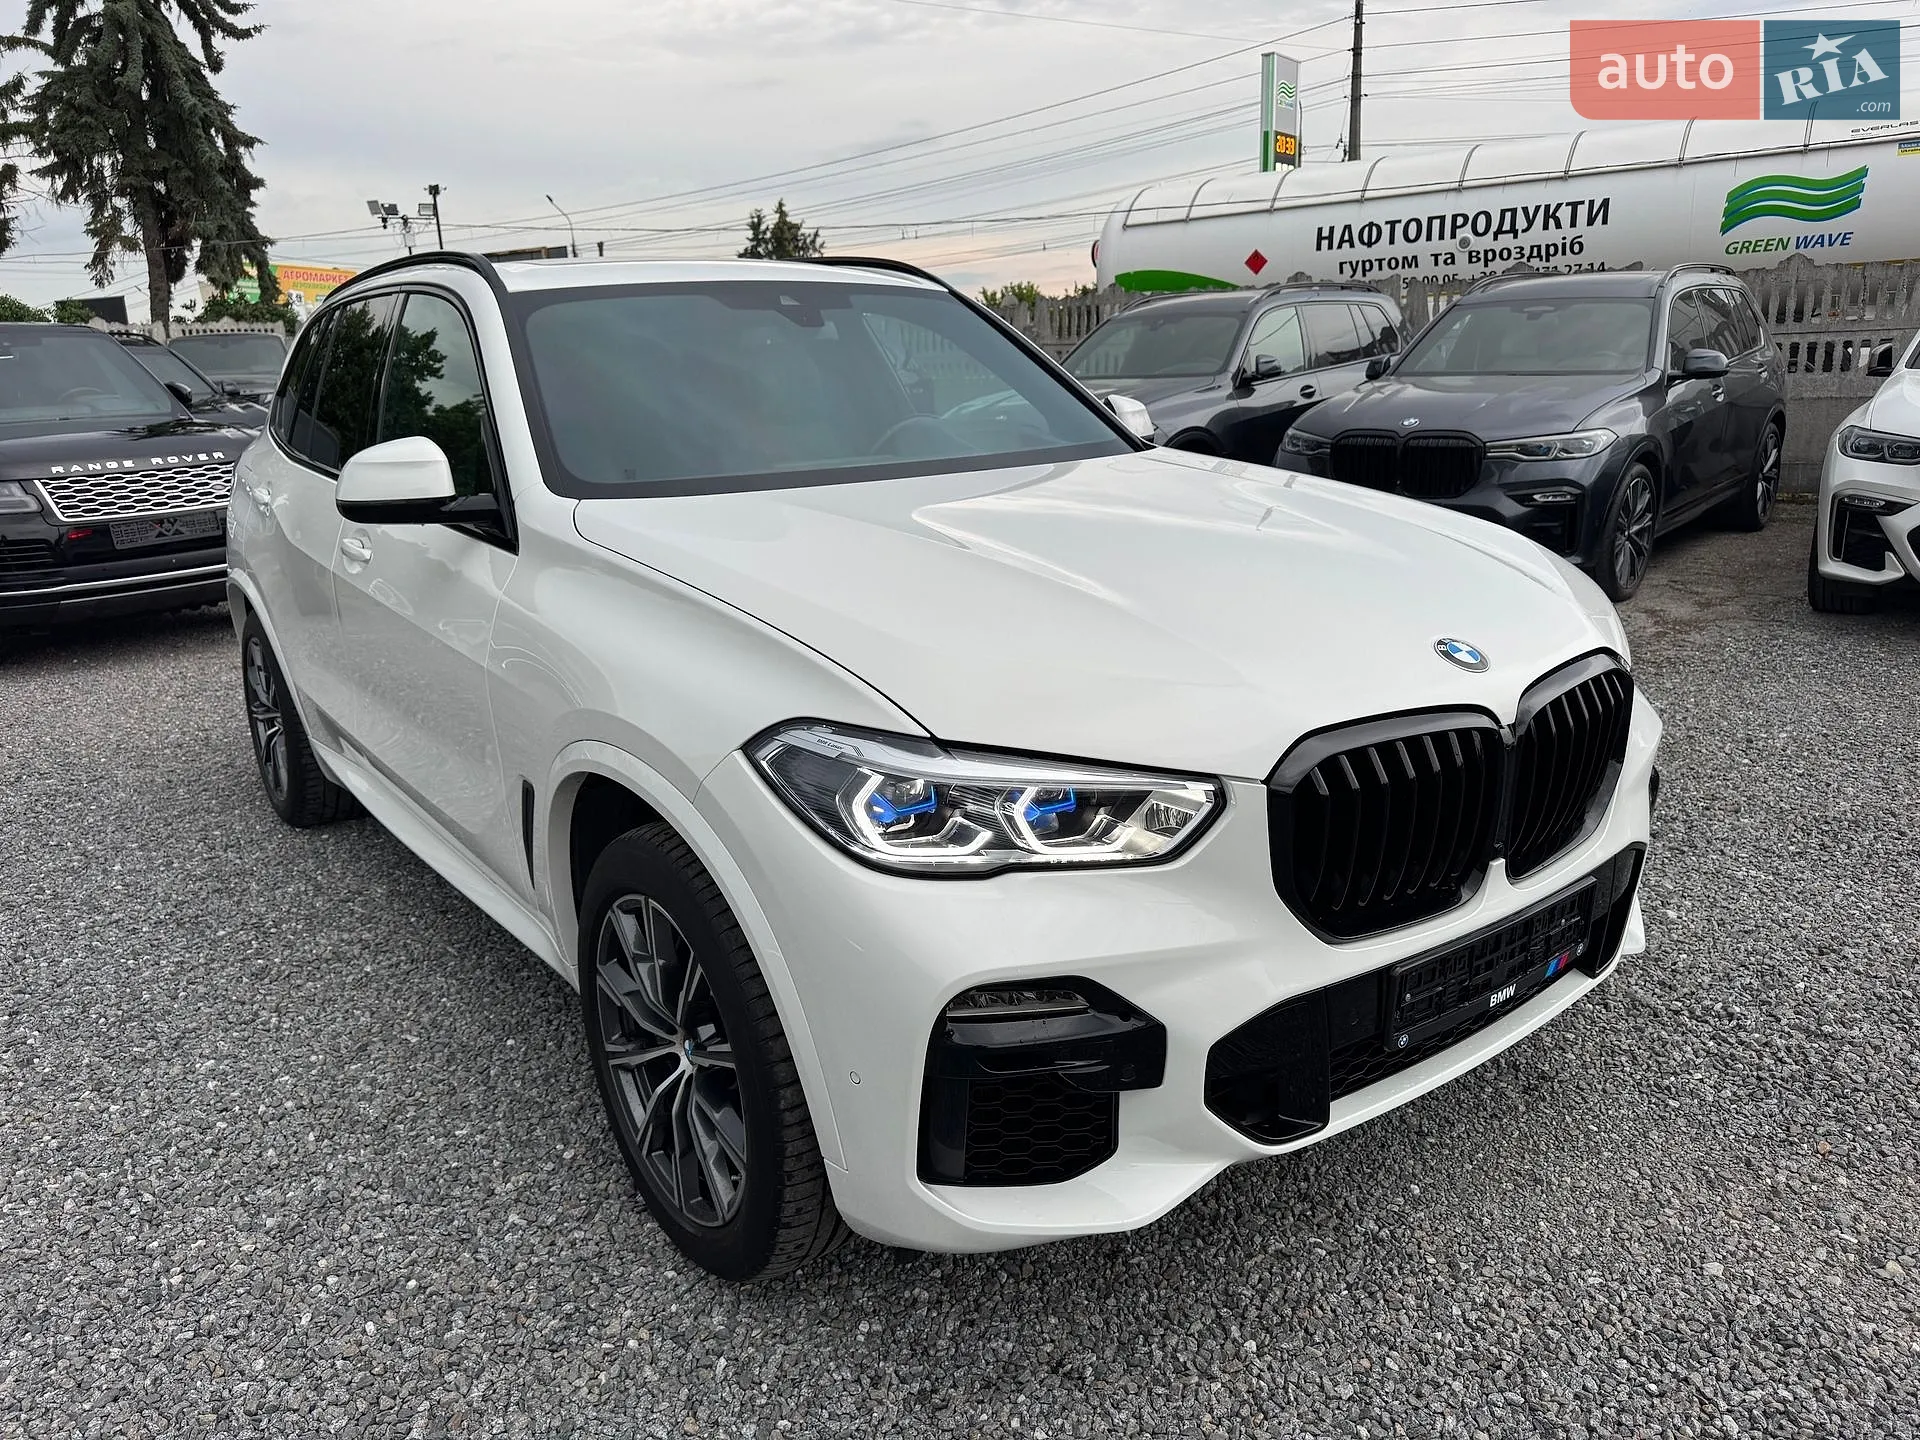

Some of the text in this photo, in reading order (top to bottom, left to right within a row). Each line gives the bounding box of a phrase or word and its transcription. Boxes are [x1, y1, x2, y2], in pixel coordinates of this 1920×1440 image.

[1315, 197, 1611, 252] НАФТОПРОДУКТИ
[1725, 231, 1854, 255] GREEN WAVE
[1338, 235, 1585, 279] гуртом та вроздріб
[51, 451, 225, 474] RANGE ROVER
[1490, 983, 1516, 1007] BMW
